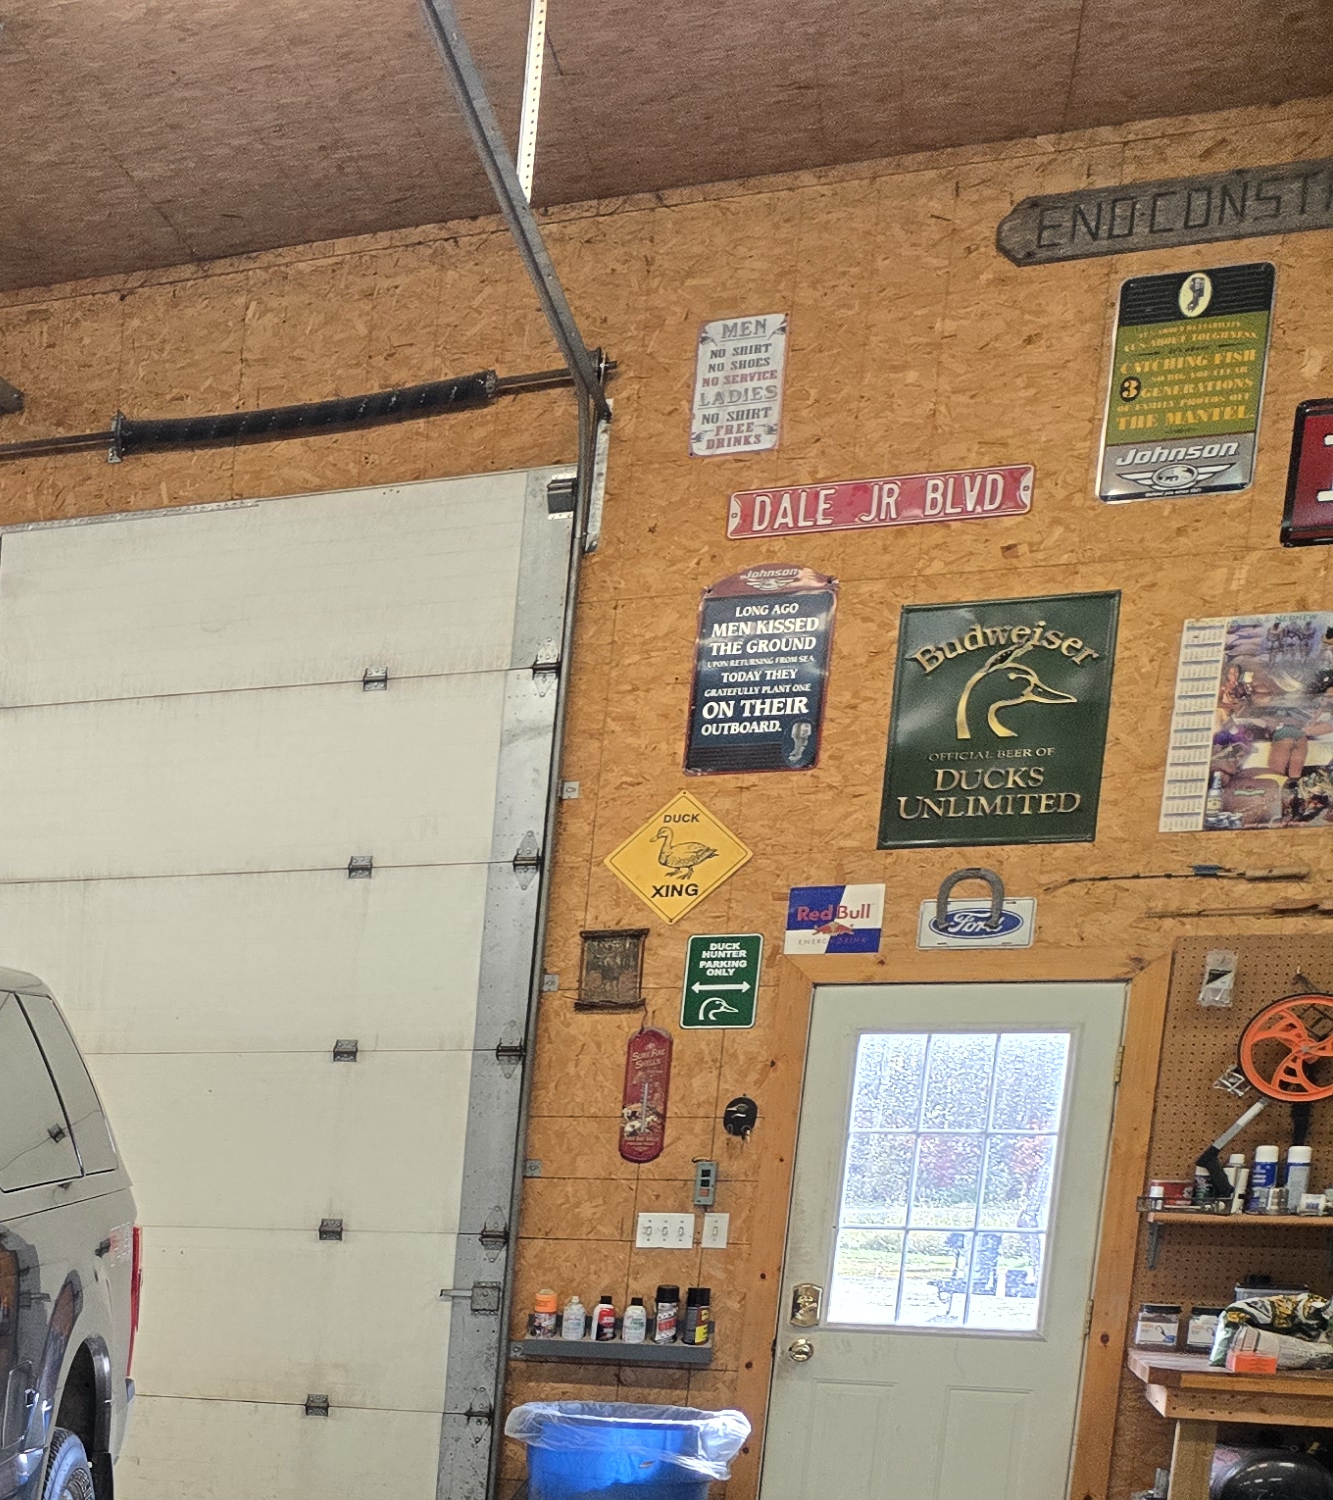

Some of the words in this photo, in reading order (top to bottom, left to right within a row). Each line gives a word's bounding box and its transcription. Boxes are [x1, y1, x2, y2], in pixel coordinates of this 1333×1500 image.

[1149, 168, 1333, 234] CONST
[721, 318, 767, 339] MEN
[709, 348, 726, 360] NO
[732, 343, 772, 356] SHIRT
[708, 362, 725, 373] NO
[730, 356, 771, 371] SHOES
[1120, 354, 1208, 375] CATCHING
[1214, 349, 1256, 365] FISH
[701, 376, 719, 388] NO
[723, 369, 778, 385] SERVICE
[698, 385, 778, 407] LADIES
[1121, 380, 1139, 398] 3
[1141, 378, 1253, 398] GENERATIONS
[701, 412, 720, 425] NO
[726, 406, 772, 422] SHIRT
[1116, 414, 1159, 431] THE
[714, 422, 755, 437] FREE
[705, 434, 762, 450] DRINKS
[1115, 442, 1239, 466] Johnson
[751, 488, 836, 532] DALE
[857, 483, 901, 522] JR
[923, 473, 1005, 516] BLVD
[743, 568, 799, 579] Johnson
[735, 605, 769, 617] LONG
[771, 603, 799, 615] AGO
[711, 623, 751, 637] MEN
[755, 617, 819, 634] KISSED
[709, 641, 743, 656] THE
[746, 636, 817, 654] GROUND
[907, 620, 1100, 674] Budweiser
[707, 660, 729, 668] UPON
[729, 657, 774, 666] RETURNING
[775, 655, 798, 664] FROM
[721, 671, 763, 683] TODAY
[764, 668, 799, 680] THEY
[704, 686, 761, 697] GRATEFULLY
[761, 684, 792, 694] PLANT
[792, 683, 812, 692] ONE
[702, 700, 735, 719] ON
[740, 696, 809, 717] THEIR
[701, 721, 782, 736] OUTBOARD.
[928, 750, 993, 762] OFFICIAL
[997, 748, 1032, 759] BEER
[1035, 747, 1055, 757] OF
[934, 766, 1046, 792] DUCKS
[897, 792, 1081, 820] UNLIMITED
[663, 813, 701, 824] DUCK
[650, 883, 699, 898] XING
[797, 904, 833, 922] Red
[837, 903, 871, 920] Bull
[702, 950, 747, 959] HUNTER
[710, 942, 740, 951] DUCK
[699, 960, 748, 969] PARKING
[706, 968, 735, 977] ONLY
